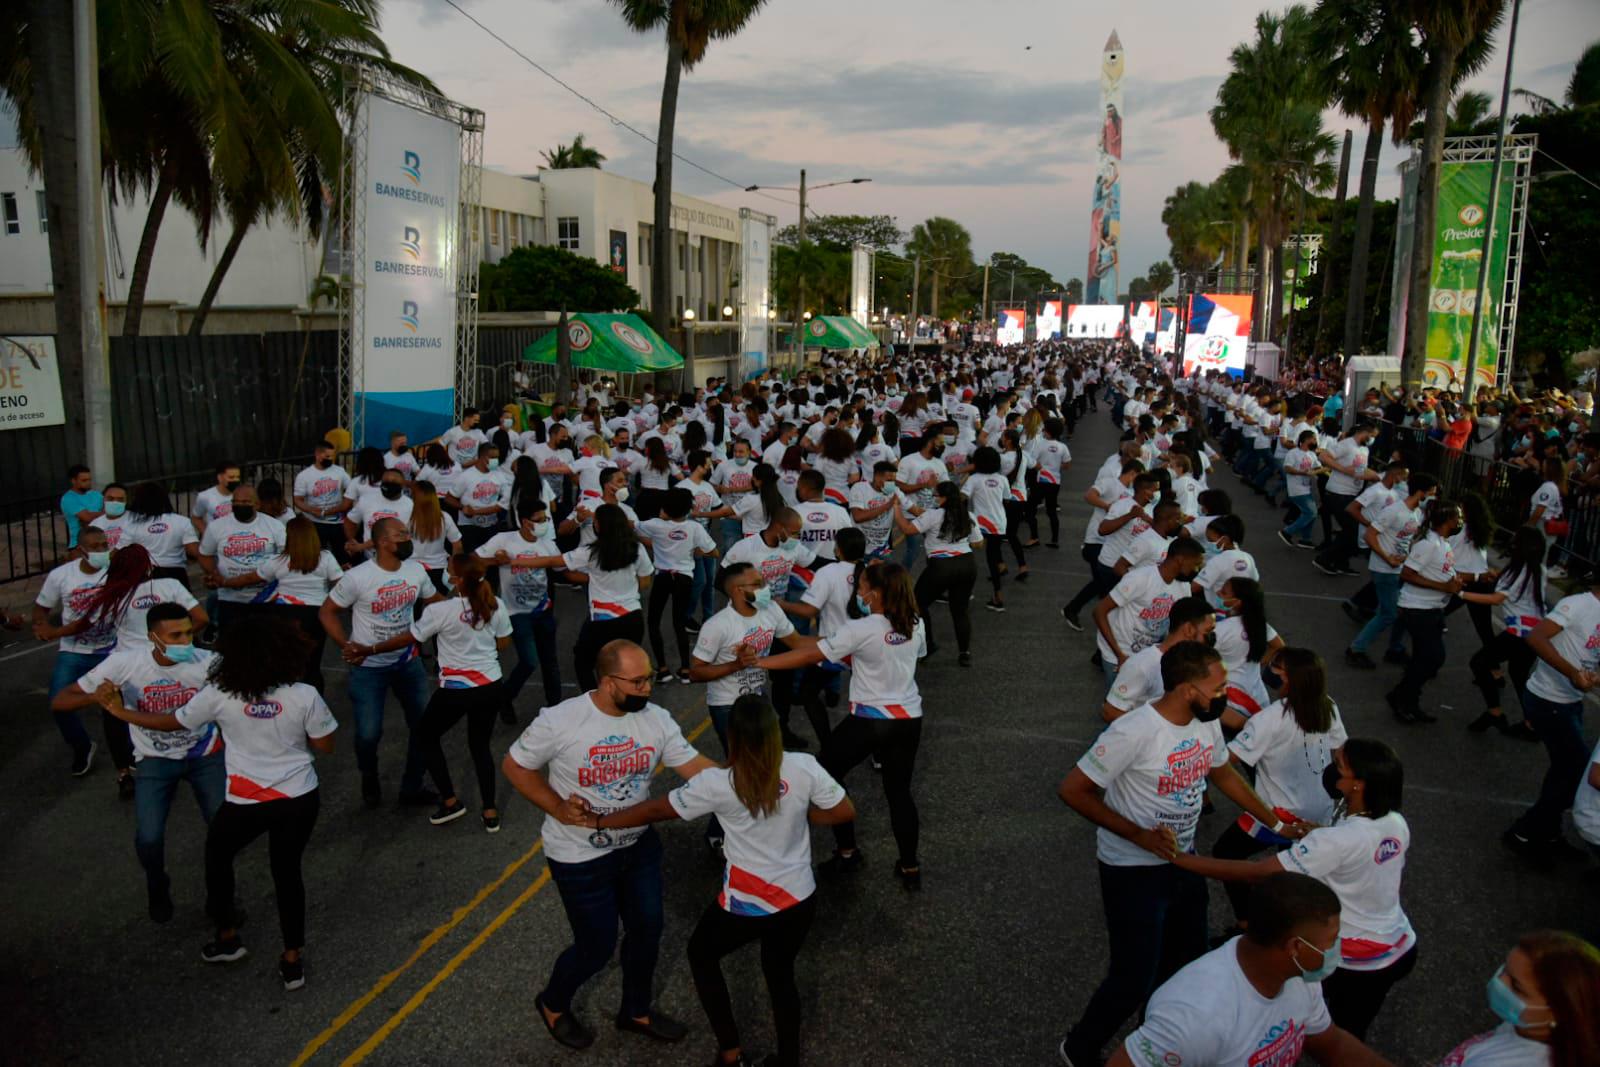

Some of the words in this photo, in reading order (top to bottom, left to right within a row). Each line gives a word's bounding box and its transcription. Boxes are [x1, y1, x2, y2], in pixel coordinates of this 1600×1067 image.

[376, 183, 445, 207] BANRESERVAS
[1442, 227, 1498, 241] Presidee
[375, 260, 444, 279] BANRESERVAS
[373, 337, 442, 349] BANRESERVAS
[7, 413, 17, 421] de
[19, 412, 45, 420] acceso
[249, 704, 279, 714] OPAL
[578, 746, 656, 787] BACHATA
[1157, 745, 1214, 796] BACHATA
